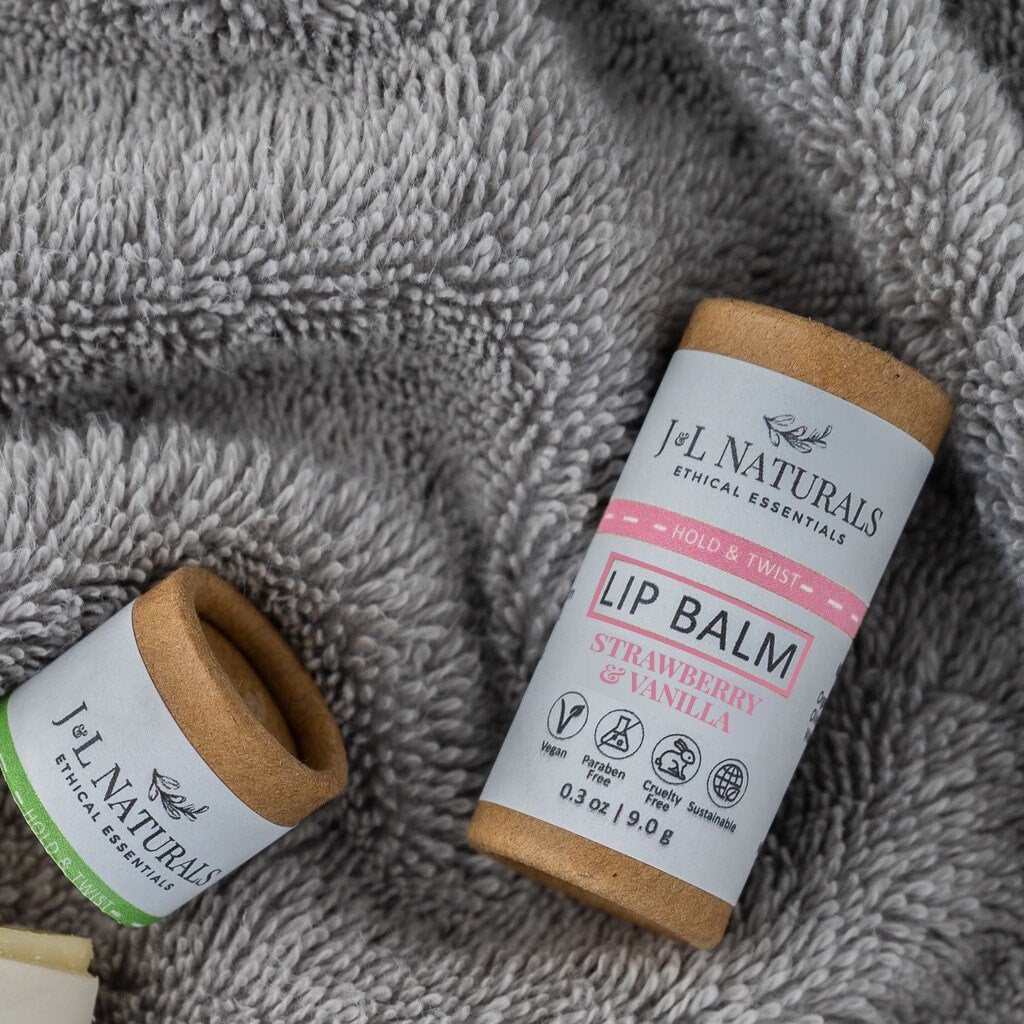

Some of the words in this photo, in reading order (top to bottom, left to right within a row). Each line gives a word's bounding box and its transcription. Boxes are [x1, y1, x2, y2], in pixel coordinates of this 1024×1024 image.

[654, 419, 706, 460] J&L
[714, 434, 884, 537] NATURALS
[673, 465, 739, 498] ETHICAL
[748, 493, 846, 545] ESSENTIALS
[672, 525, 721, 554] HOLD
[726, 546, 739, 562] &
[746, 554, 802, 589] TWIST
[599, 570, 660, 615] LIP
[670, 595, 798, 679] BALM
[590, 632, 764, 717] STRAWBERRY
[599, 664, 625, 684] &
[630, 672, 731, 733] VANILLA
[541, 740, 567, 759] Vegan
[582, 755, 626, 780] Paraben
[587, 769, 611, 787] Free
[52, 701, 103, 768] J&L
[91, 763, 223, 887] NATURALS
[55, 754, 103, 822] ETHICAL
[102, 825, 174, 891] ESSENTIALS
[559, 782, 586, 805] 0.3
[589, 797, 610, 815] oz
[627, 810, 658, 834] 9.0
[661, 827, 674, 846] g
[643, 780, 682, 807] Cruelty
[646, 793, 669, 812] Free
[687, 801, 737, 833] Sustainable
